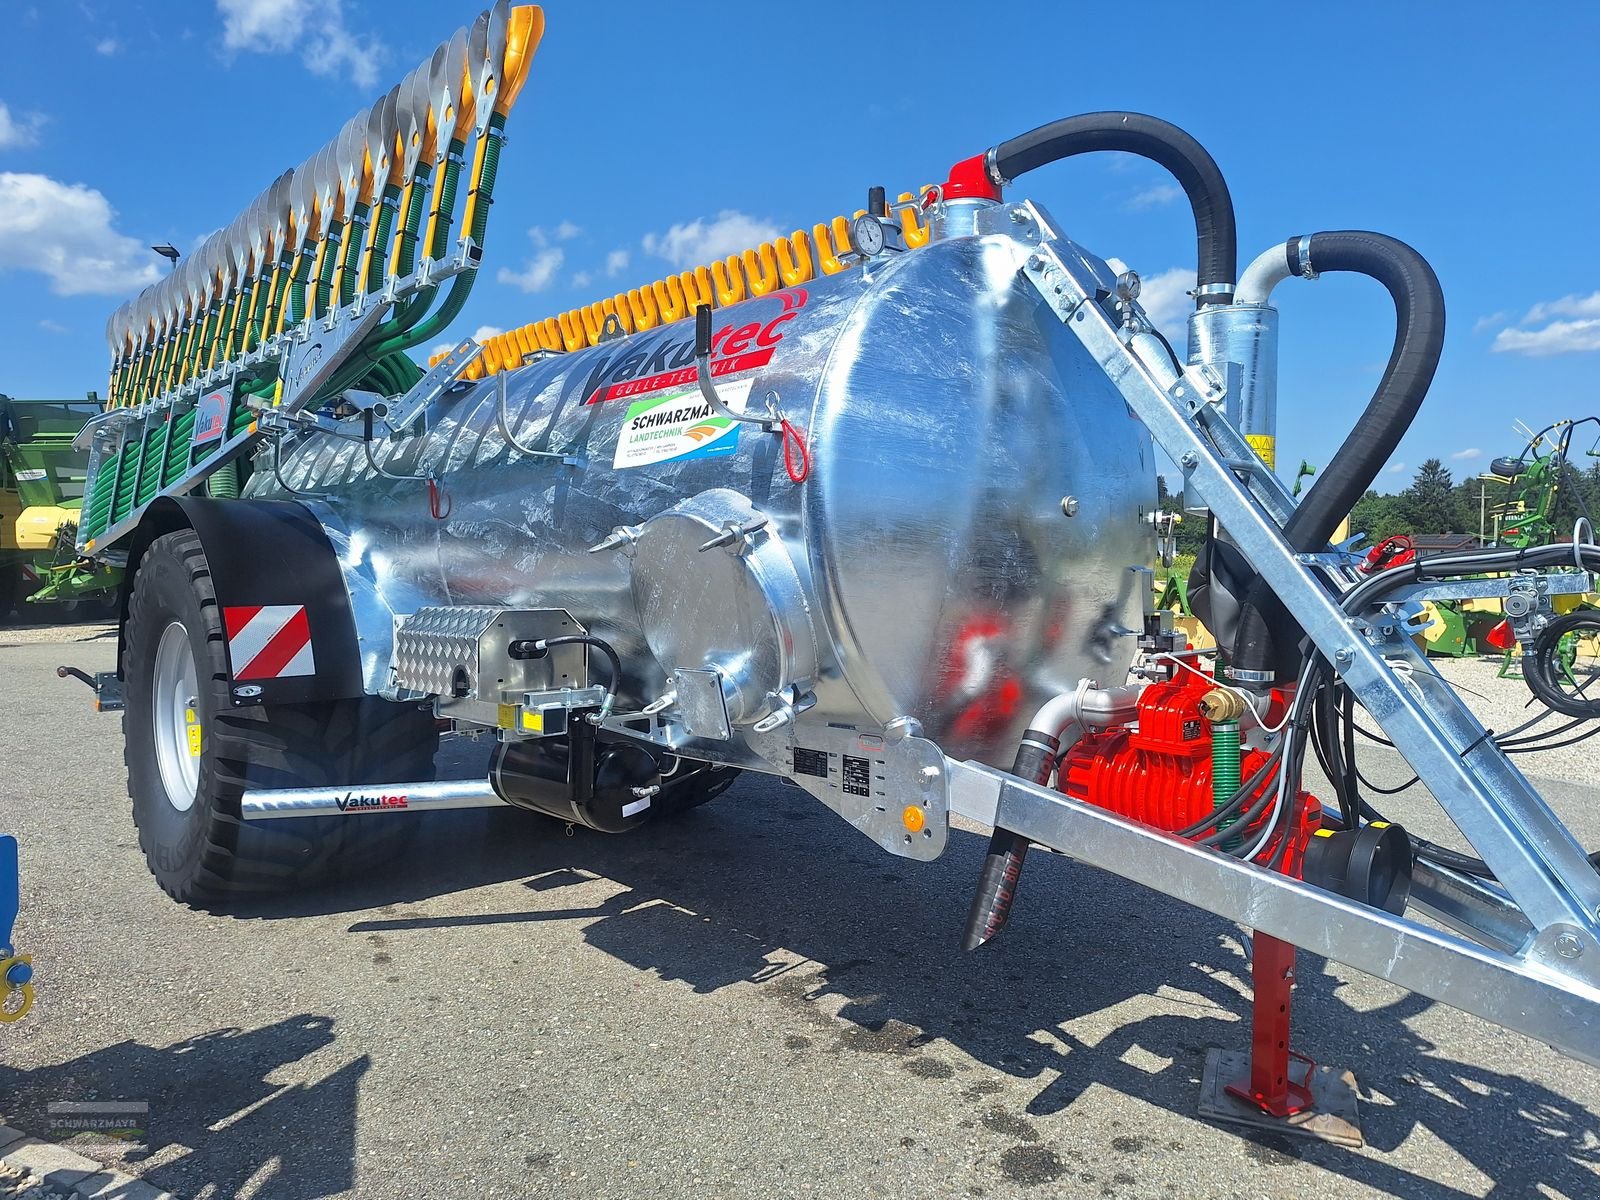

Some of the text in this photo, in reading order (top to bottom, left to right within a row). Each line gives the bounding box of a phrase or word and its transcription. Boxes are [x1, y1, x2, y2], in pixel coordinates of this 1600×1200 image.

[631, 400, 729, 431] SCHWARZMA
[629, 426, 684, 444] LANDTECHNIK
[335, 792, 408, 812] Vakutec
